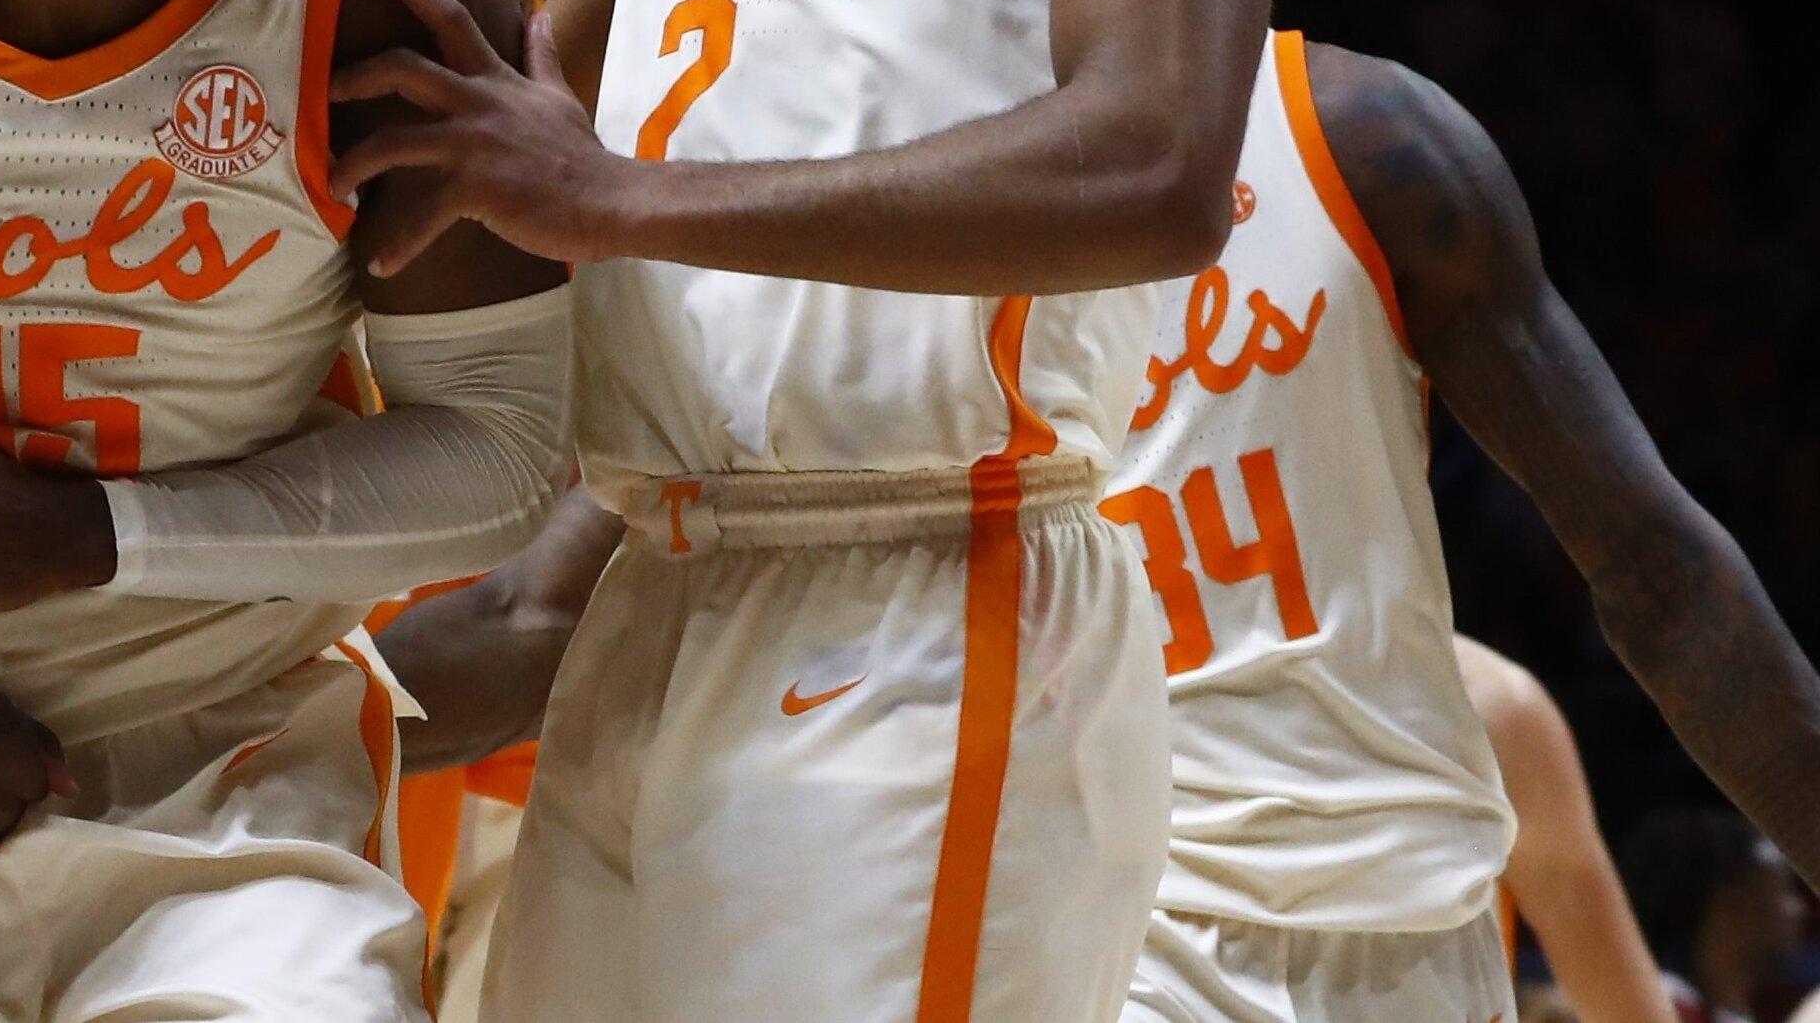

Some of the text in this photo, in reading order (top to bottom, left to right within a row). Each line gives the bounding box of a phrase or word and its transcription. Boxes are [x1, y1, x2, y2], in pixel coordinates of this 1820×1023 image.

[183, 73, 260, 150] SEC
[166, 141, 266, 176] GRADUATE
[1129, 264, 1327, 432] ols
[660, 480, 703, 555] T
[1096, 446, 1321, 678] 34
